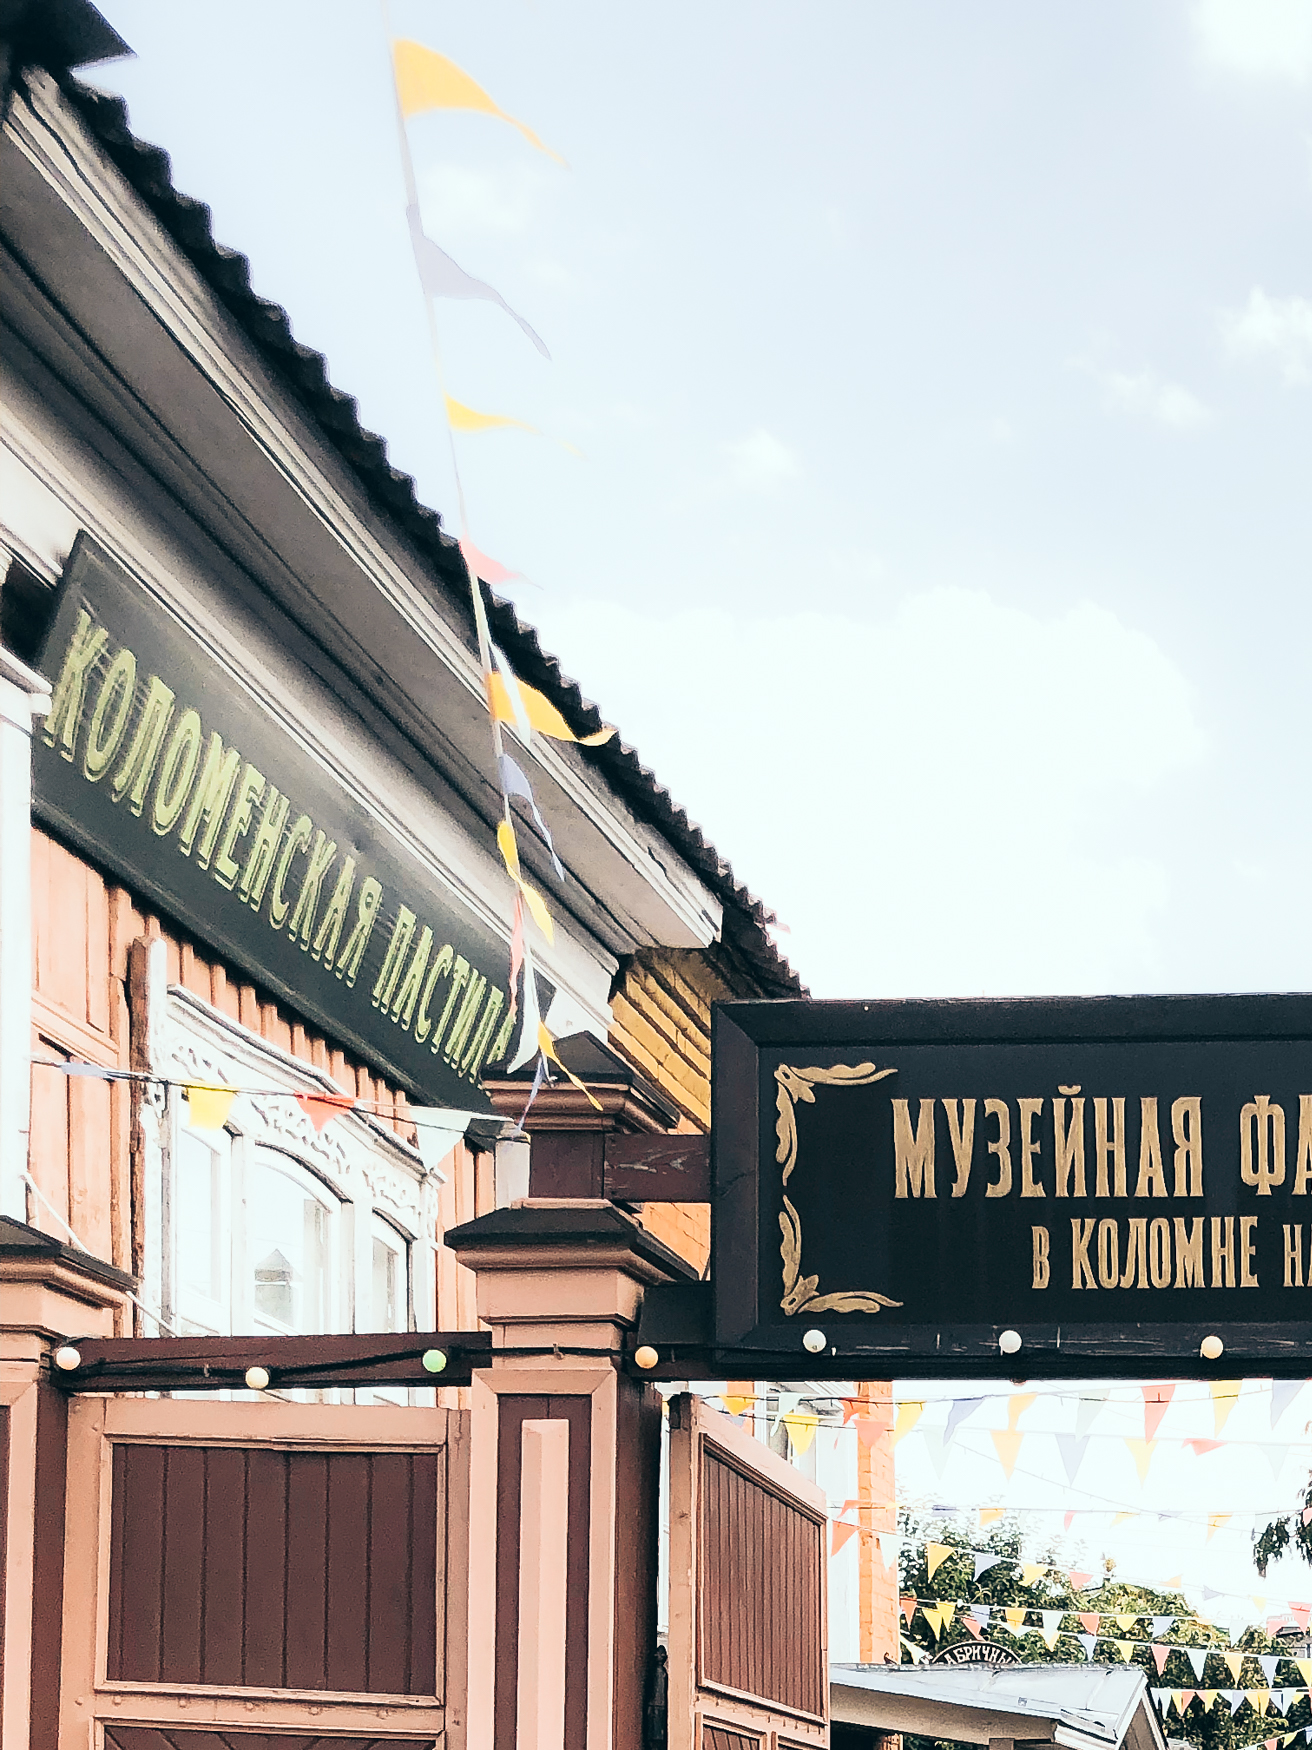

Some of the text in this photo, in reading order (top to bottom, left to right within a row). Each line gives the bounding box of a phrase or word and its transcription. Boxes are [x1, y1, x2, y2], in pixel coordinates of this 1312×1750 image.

[42, 609, 383, 986] КОЛОМЕНСКАЯ
[891, 1085, 1203, 1198] МУЗЕЙНАЯ
[1032, 1226, 1050, 1288] В
[1071, 1216, 1259, 1289] КОЛОМНЕ
[940, 1645, 1018, 1664] АБРИЧНЫ
